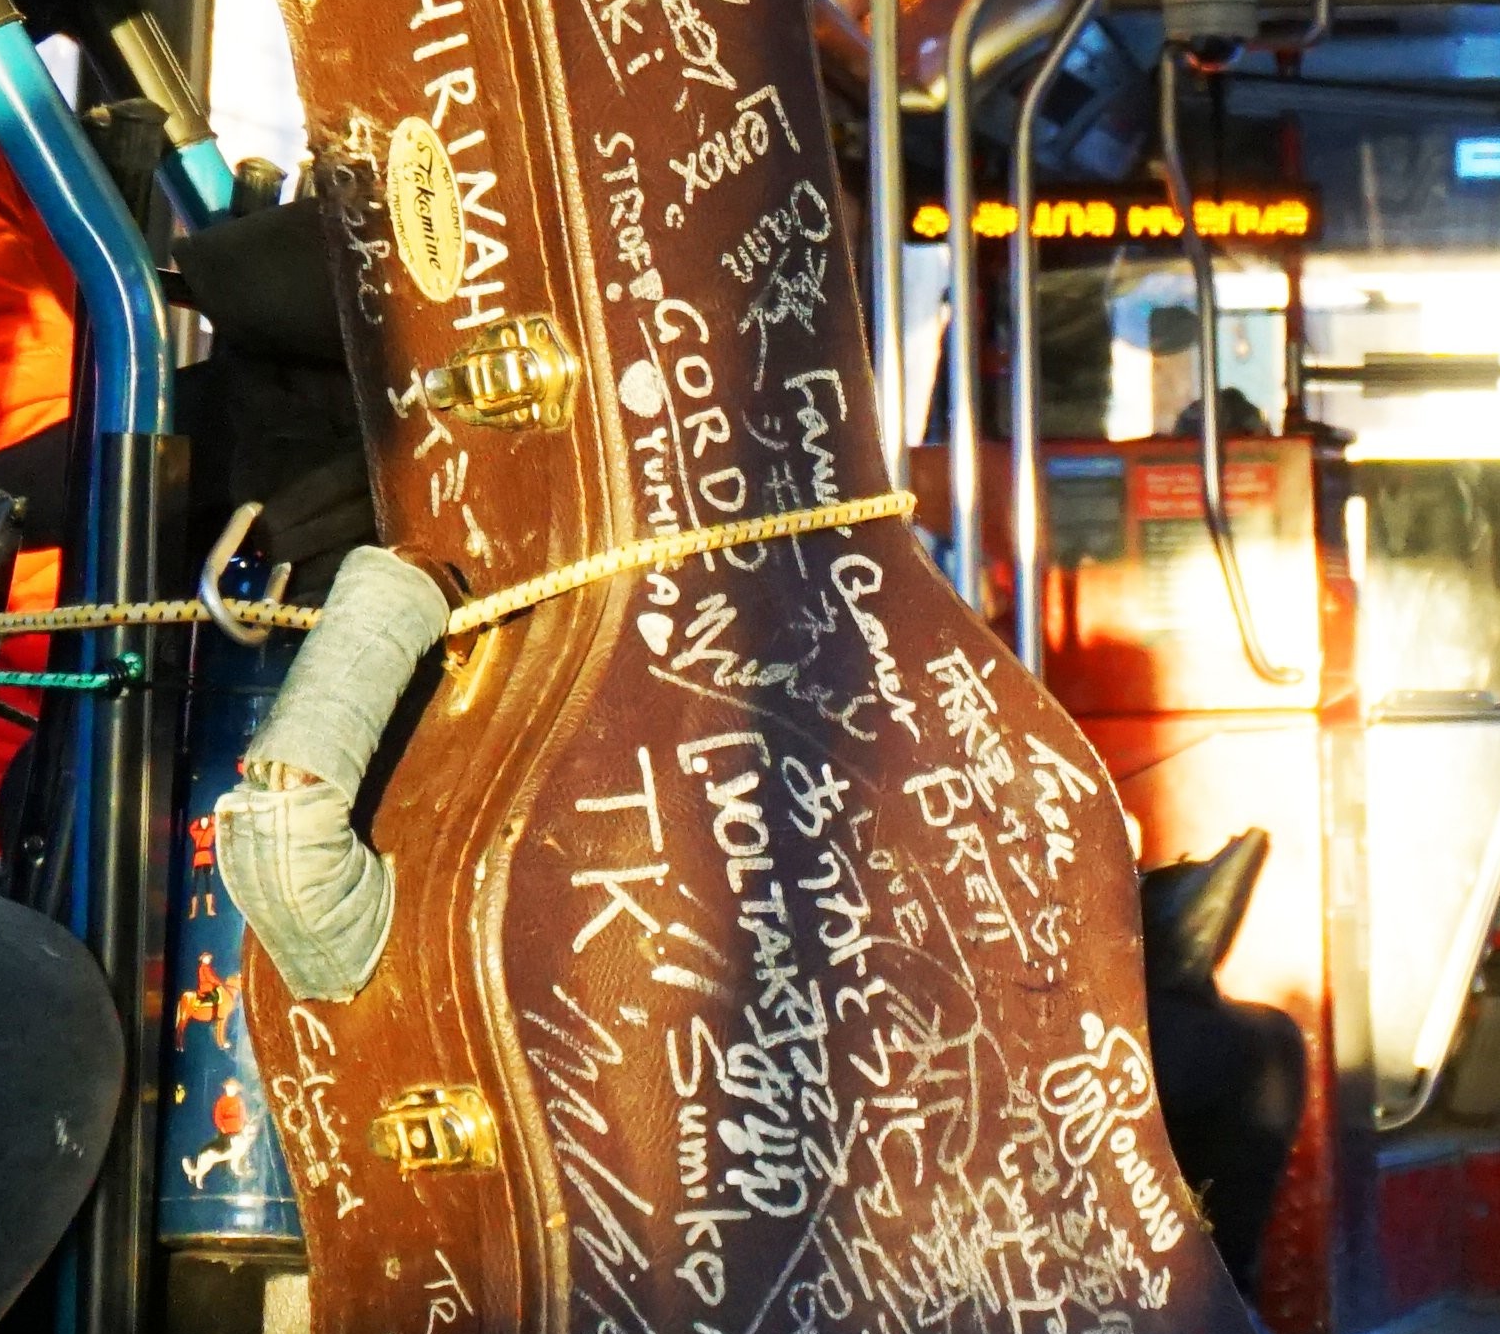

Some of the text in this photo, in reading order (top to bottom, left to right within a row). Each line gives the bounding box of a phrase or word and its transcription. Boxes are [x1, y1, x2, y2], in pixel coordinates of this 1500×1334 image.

[408, 141, 444, 272] Takamine
[666, 1015, 752, 1307] Sumiko
[1109, 1126, 1186, 1254] AYANO
